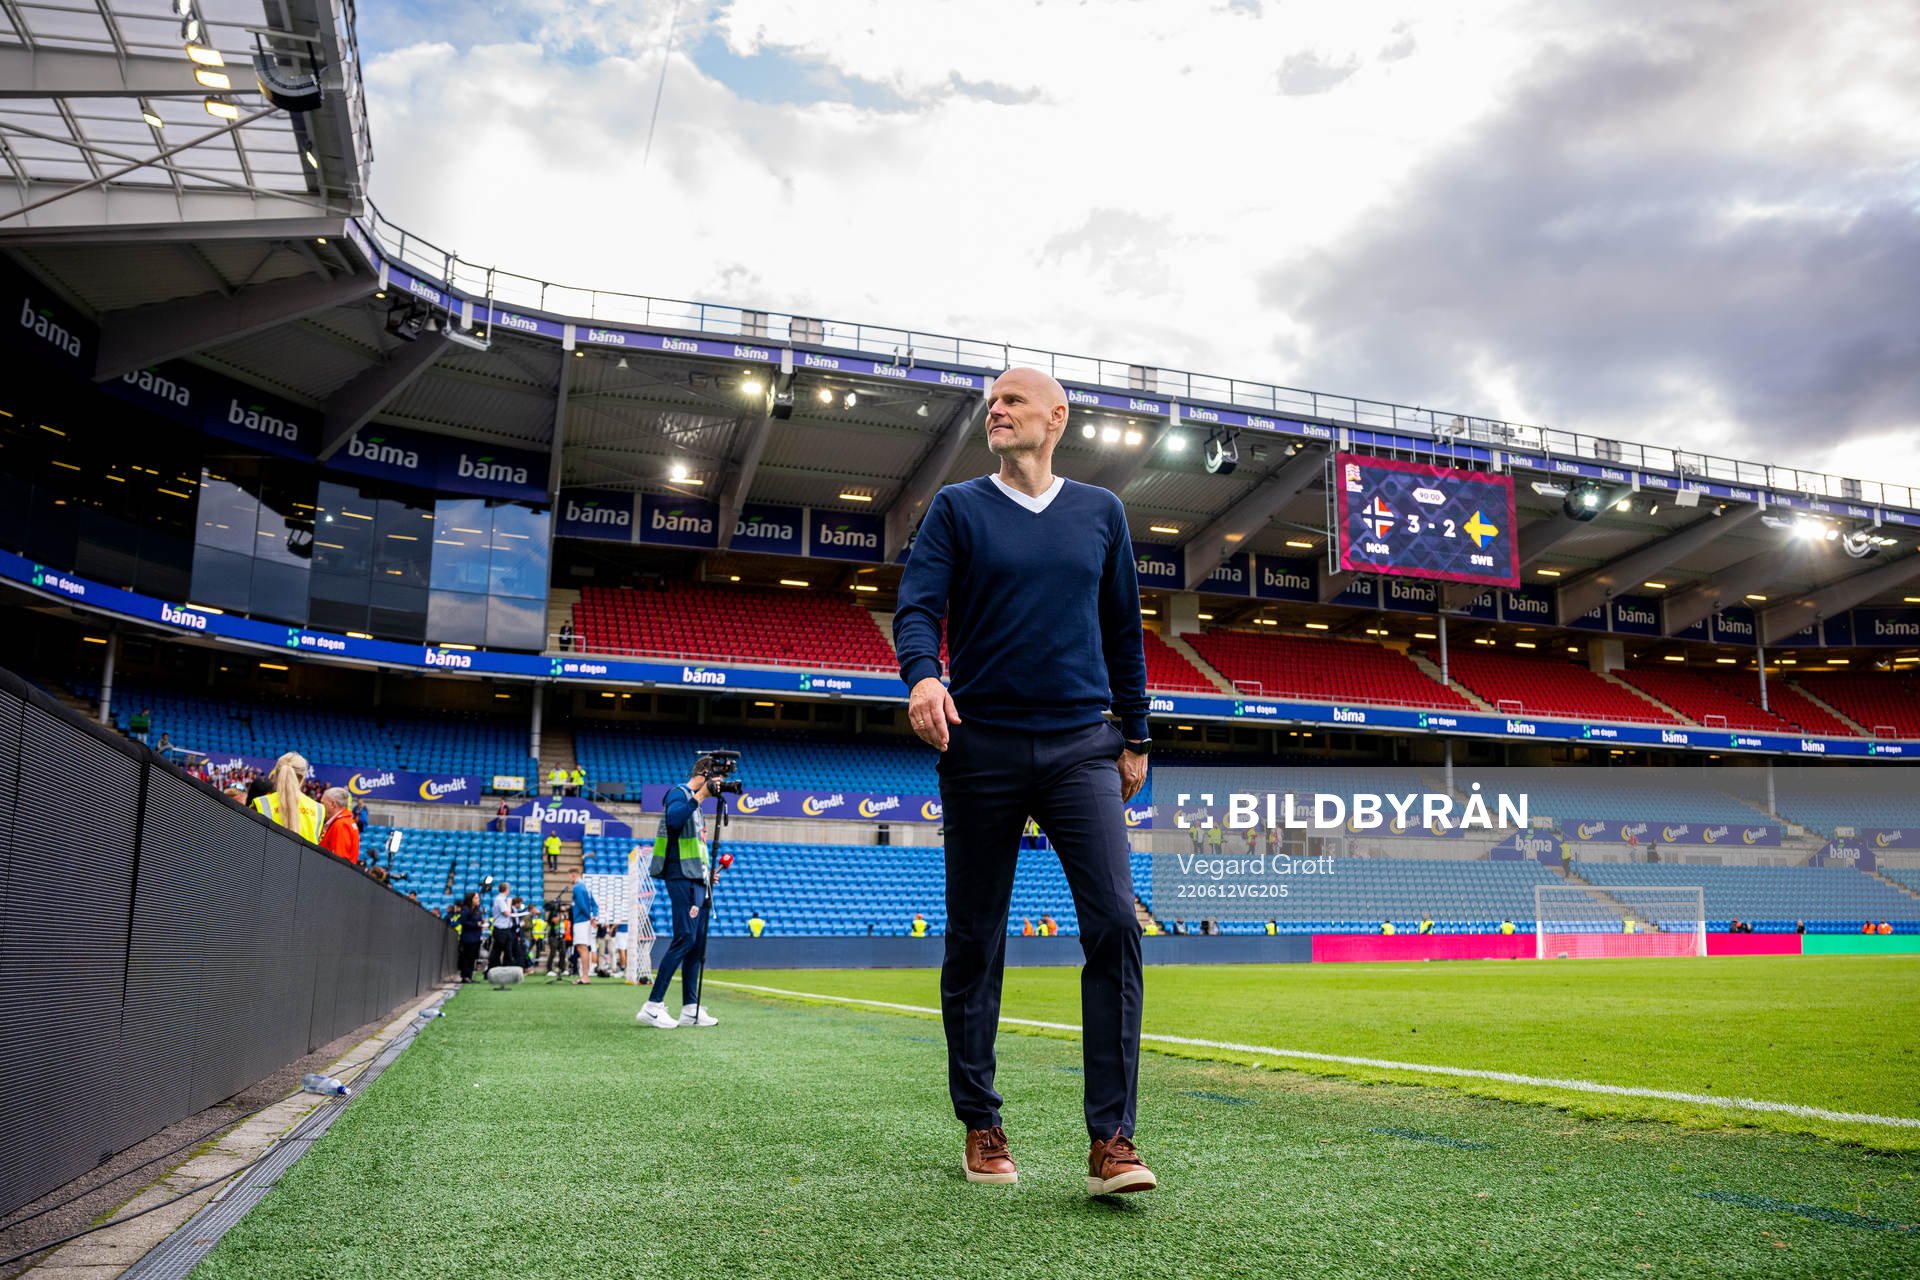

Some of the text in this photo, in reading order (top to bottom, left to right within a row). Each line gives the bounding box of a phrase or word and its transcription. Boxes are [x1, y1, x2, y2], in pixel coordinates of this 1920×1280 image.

[410, 279, 440, 304] bama
[20, 298, 81, 357] bama
[501, 312, 538, 332] bama
[588, 329, 625, 345] bama
[662, 337, 698, 352] bama
[734, 345, 768, 360] bama
[805, 353, 839, 368] bama
[874, 363, 906, 378] bama
[940, 371, 973, 387] bama
[1068, 390, 1099, 405] bama
[1129, 399, 1159, 413] bama
[228, 399, 298, 441] bama
[1189, 408, 1218, 422] bama
[1247, 415, 1275, 430] bama
[1303, 423, 1330, 438] bama
[348, 433, 418, 469] bama
[1508, 454, 1532, 467] bama
[1556, 461, 1579, 474] bama
[458, 454, 528, 484] bama
[1602, 468, 1624, 481] bama
[1646, 475, 1668, 487] bama
[1772, 495, 1791, 506] bma
[566, 501, 630, 526] bama
[652, 510, 712, 534] bama
[1407, 514, 1420, 534] 3
[1443, 519, 1456, 538] 2
[820, 525, 877, 548] bama
[1366, 543, 1390, 554] NOR
[1137, 555, 1176, 576] ama
[1471, 554, 1494, 566] SWE
[45, 574, 58, 586] om
[58, 576, 85, 596] dagen
[1264, 568, 1310, 590] bama
[1392, 582, 1434, 601] bama
[1510, 593, 1548, 614] bama
[161, 603, 207, 630] bama
[1618, 606, 1655, 624] bama
[1718, 614, 1752, 634] bama
[1875, 620, 1919, 635] bama
[301, 635, 315, 646] om
[317, 637, 345, 650] dagen
[425, 649, 471, 668] bama
[564, 662, 578, 674] om
[580, 662, 606, 676] dagen
[682, 667, 726, 685] bama
[812, 678, 826, 689] om
[826, 678, 852, 690] dagen
[1150, 697, 1174, 711] ama
[1245, 704, 1256, 714] om
[1257, 704, 1277, 715] dagen
[1334, 707, 1365, 722] bama
[1428, 717, 1438, 725] om
[1507, 720, 1535, 734] bama
[1662, 730, 1688, 744] bama
[1802, 739, 1825, 752] bama
[359, 773, 396, 790] Bendit
[430, 778, 466, 795] Bendit
[746, 792, 780, 808] Bendit
[812, 794, 845, 811] Bendit
[867, 796, 900, 814] Bendit
[532, 802, 591, 824] bama
[1131, 806, 1159, 822] Bendit
[1515, 835, 1552, 853] bama
[1830, 844, 1860, 860] bama
